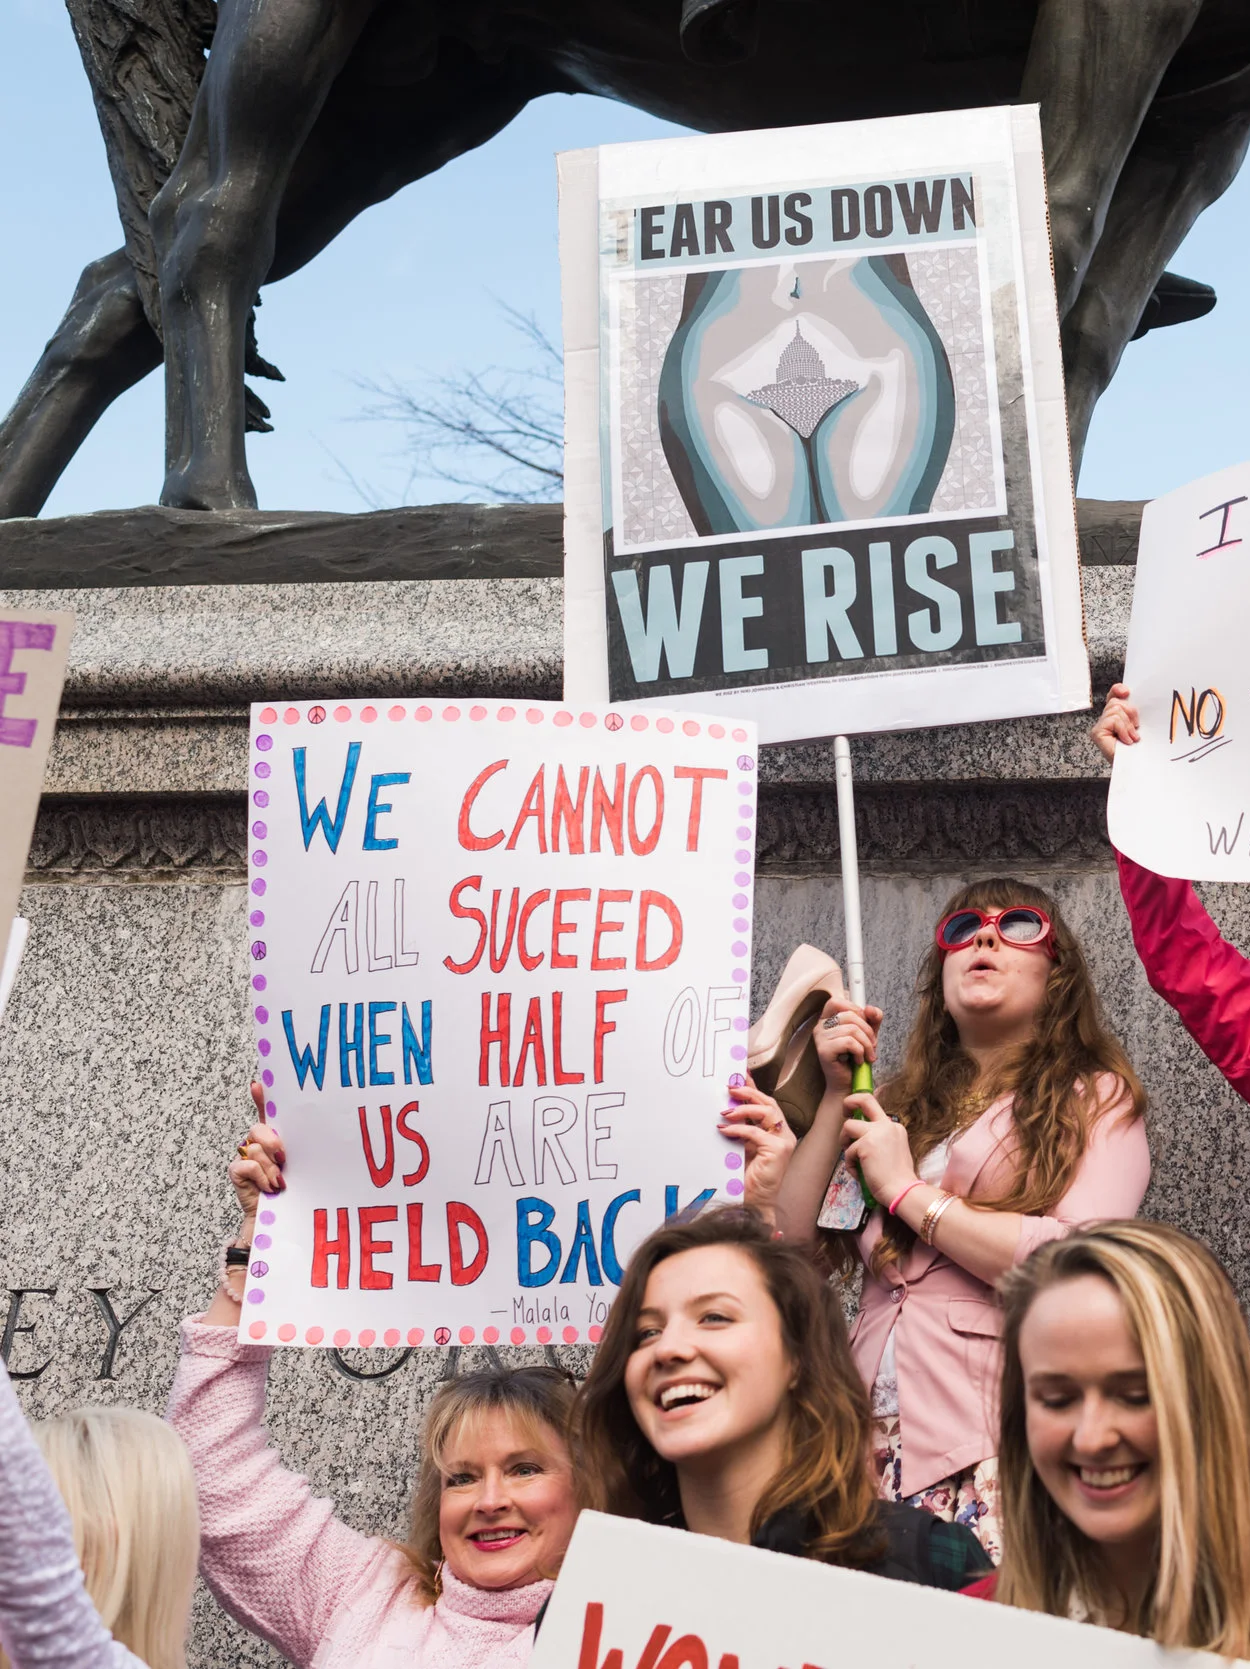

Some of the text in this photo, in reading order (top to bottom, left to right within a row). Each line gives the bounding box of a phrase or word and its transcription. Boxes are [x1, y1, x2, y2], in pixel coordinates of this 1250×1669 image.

[750, 192, 813, 250] US
[831, 177, 979, 243] DOWN
[612, 530, 1022, 684] WE RISE
[1169, 686, 1227, 744] NO
[292, 742, 729, 857] WE CANNOT
[311, 875, 683, 975] ALL SUCEED
[281, 985, 743, 1091] WHEN HALF OF
[358, 1092, 626, 1188] US ARE
[311, 1202, 488, 1291] HELD
